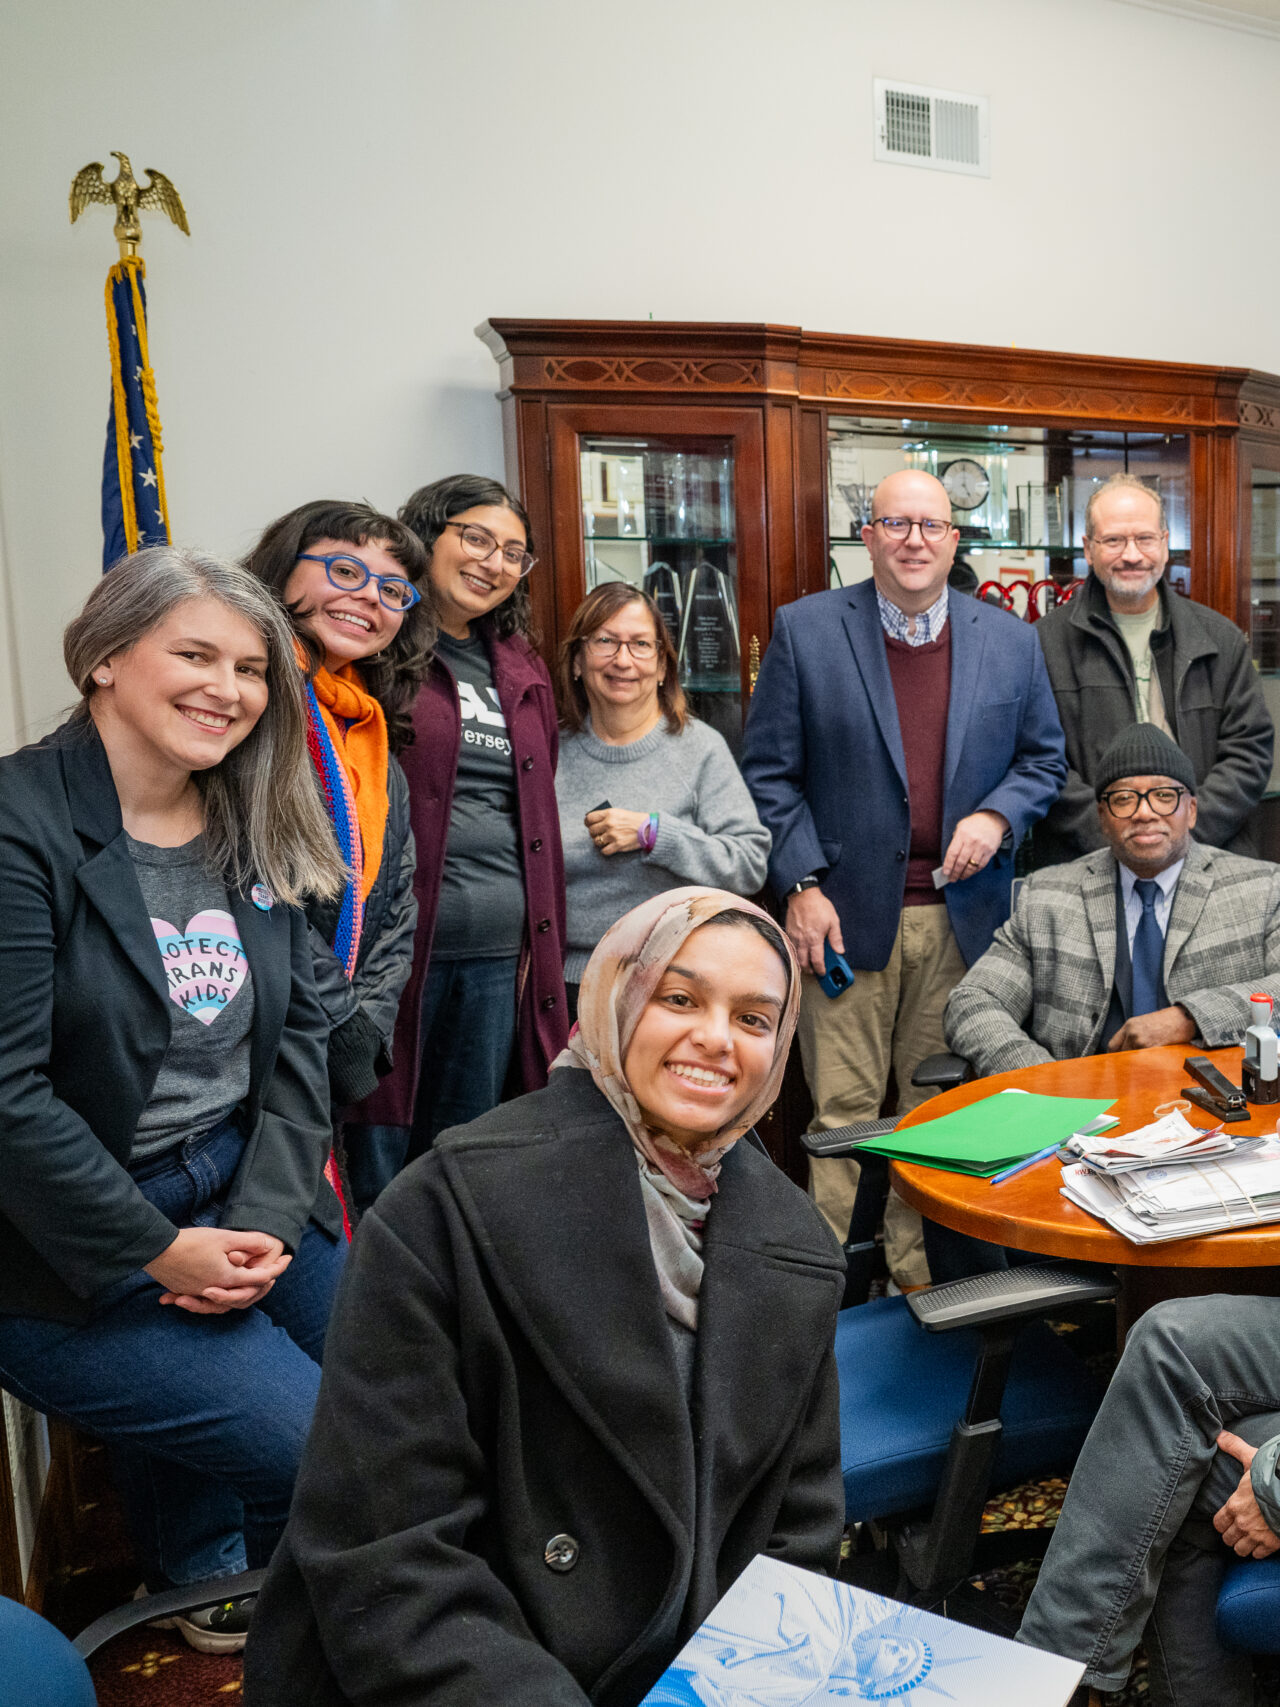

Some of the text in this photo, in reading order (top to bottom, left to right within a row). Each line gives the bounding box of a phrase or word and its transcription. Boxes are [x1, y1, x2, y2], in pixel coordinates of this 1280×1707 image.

[461, 725, 512, 756] ersey
[162, 938, 244, 962] OTECT
[179, 983, 231, 1010] KIDS
